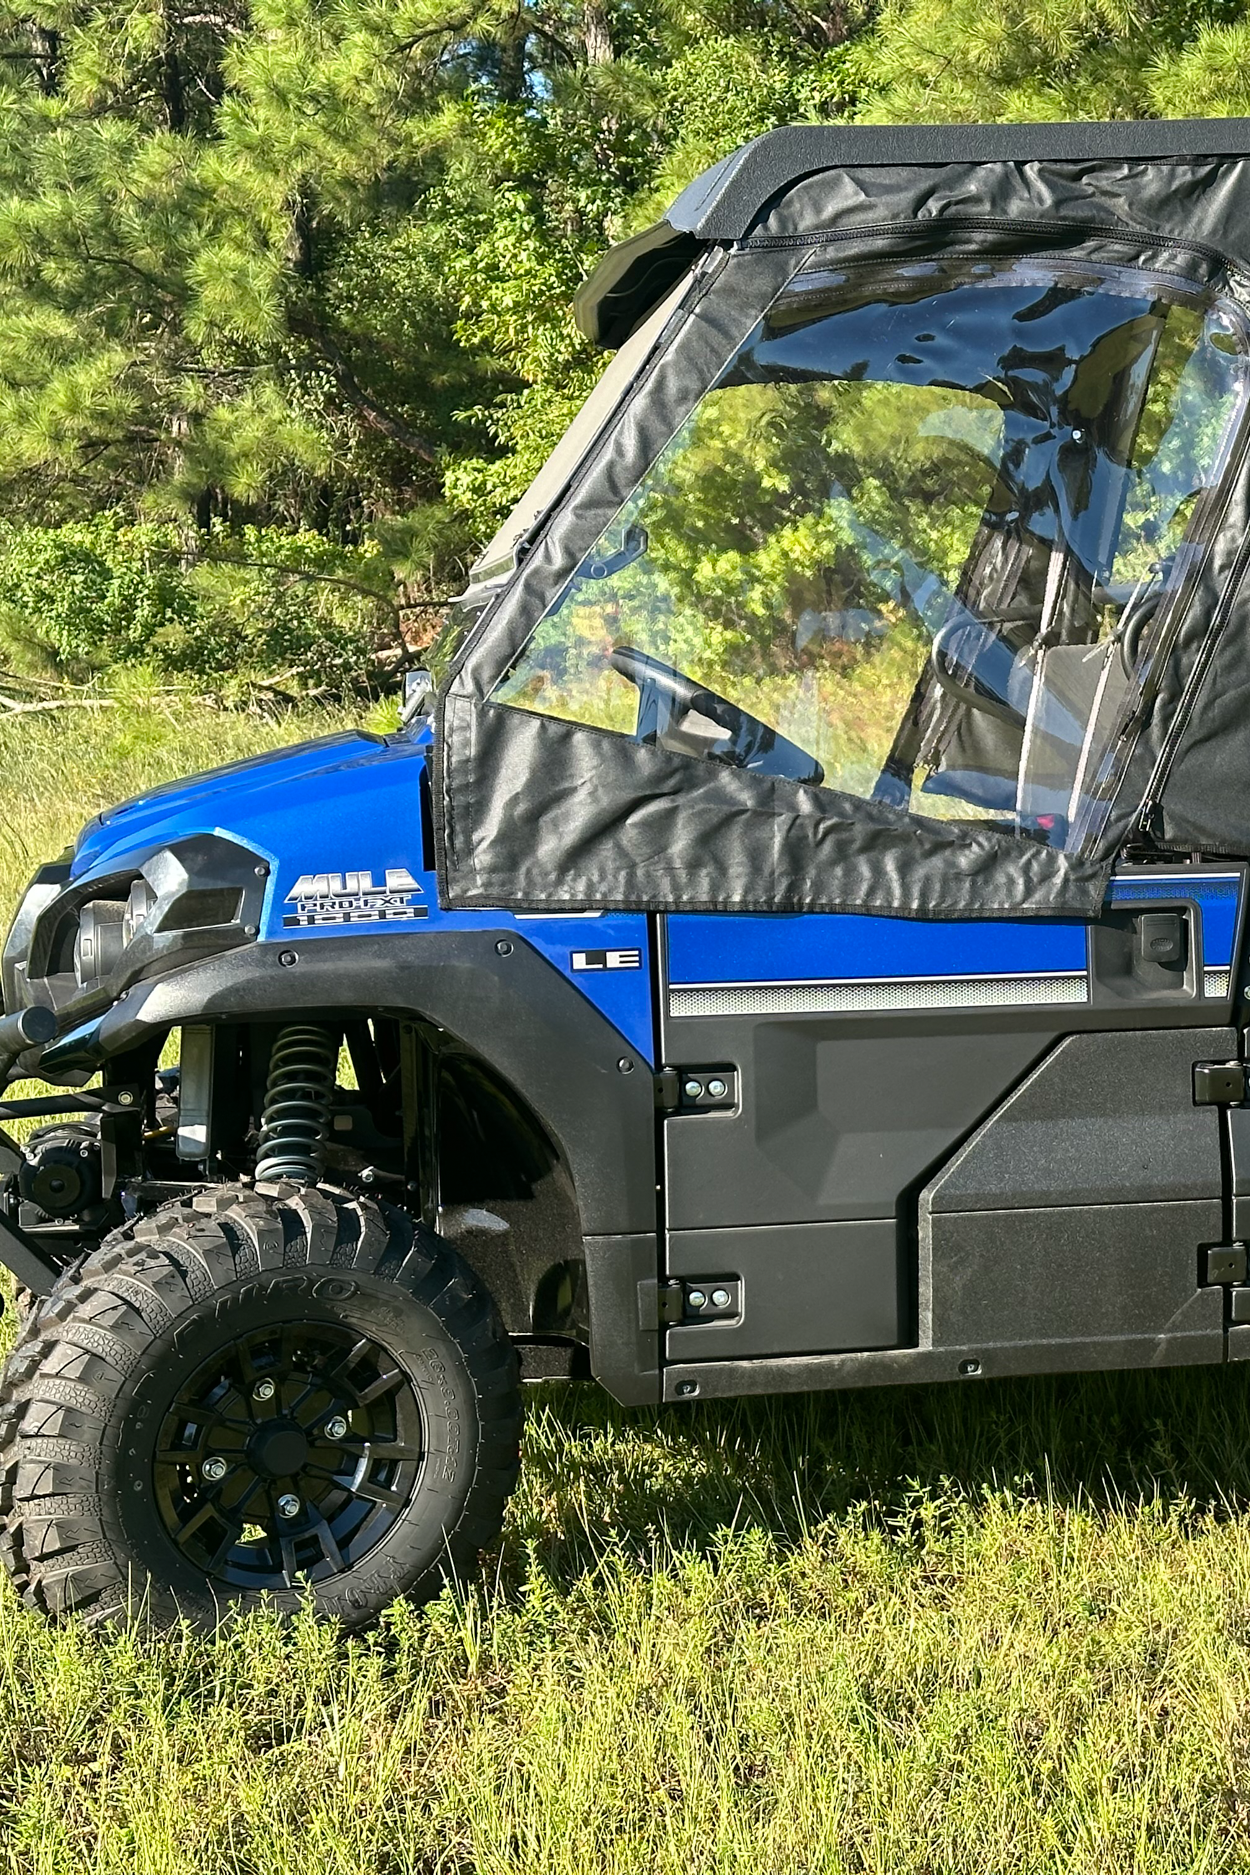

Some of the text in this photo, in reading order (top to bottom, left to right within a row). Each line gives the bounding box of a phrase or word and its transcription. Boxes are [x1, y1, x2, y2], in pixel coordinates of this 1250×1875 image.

[284, 868, 425, 903] MULE
[297, 894, 412, 914] PRO-FXT
[296, 907, 415, 926] 1000
[571, 950, 641, 971] LE
